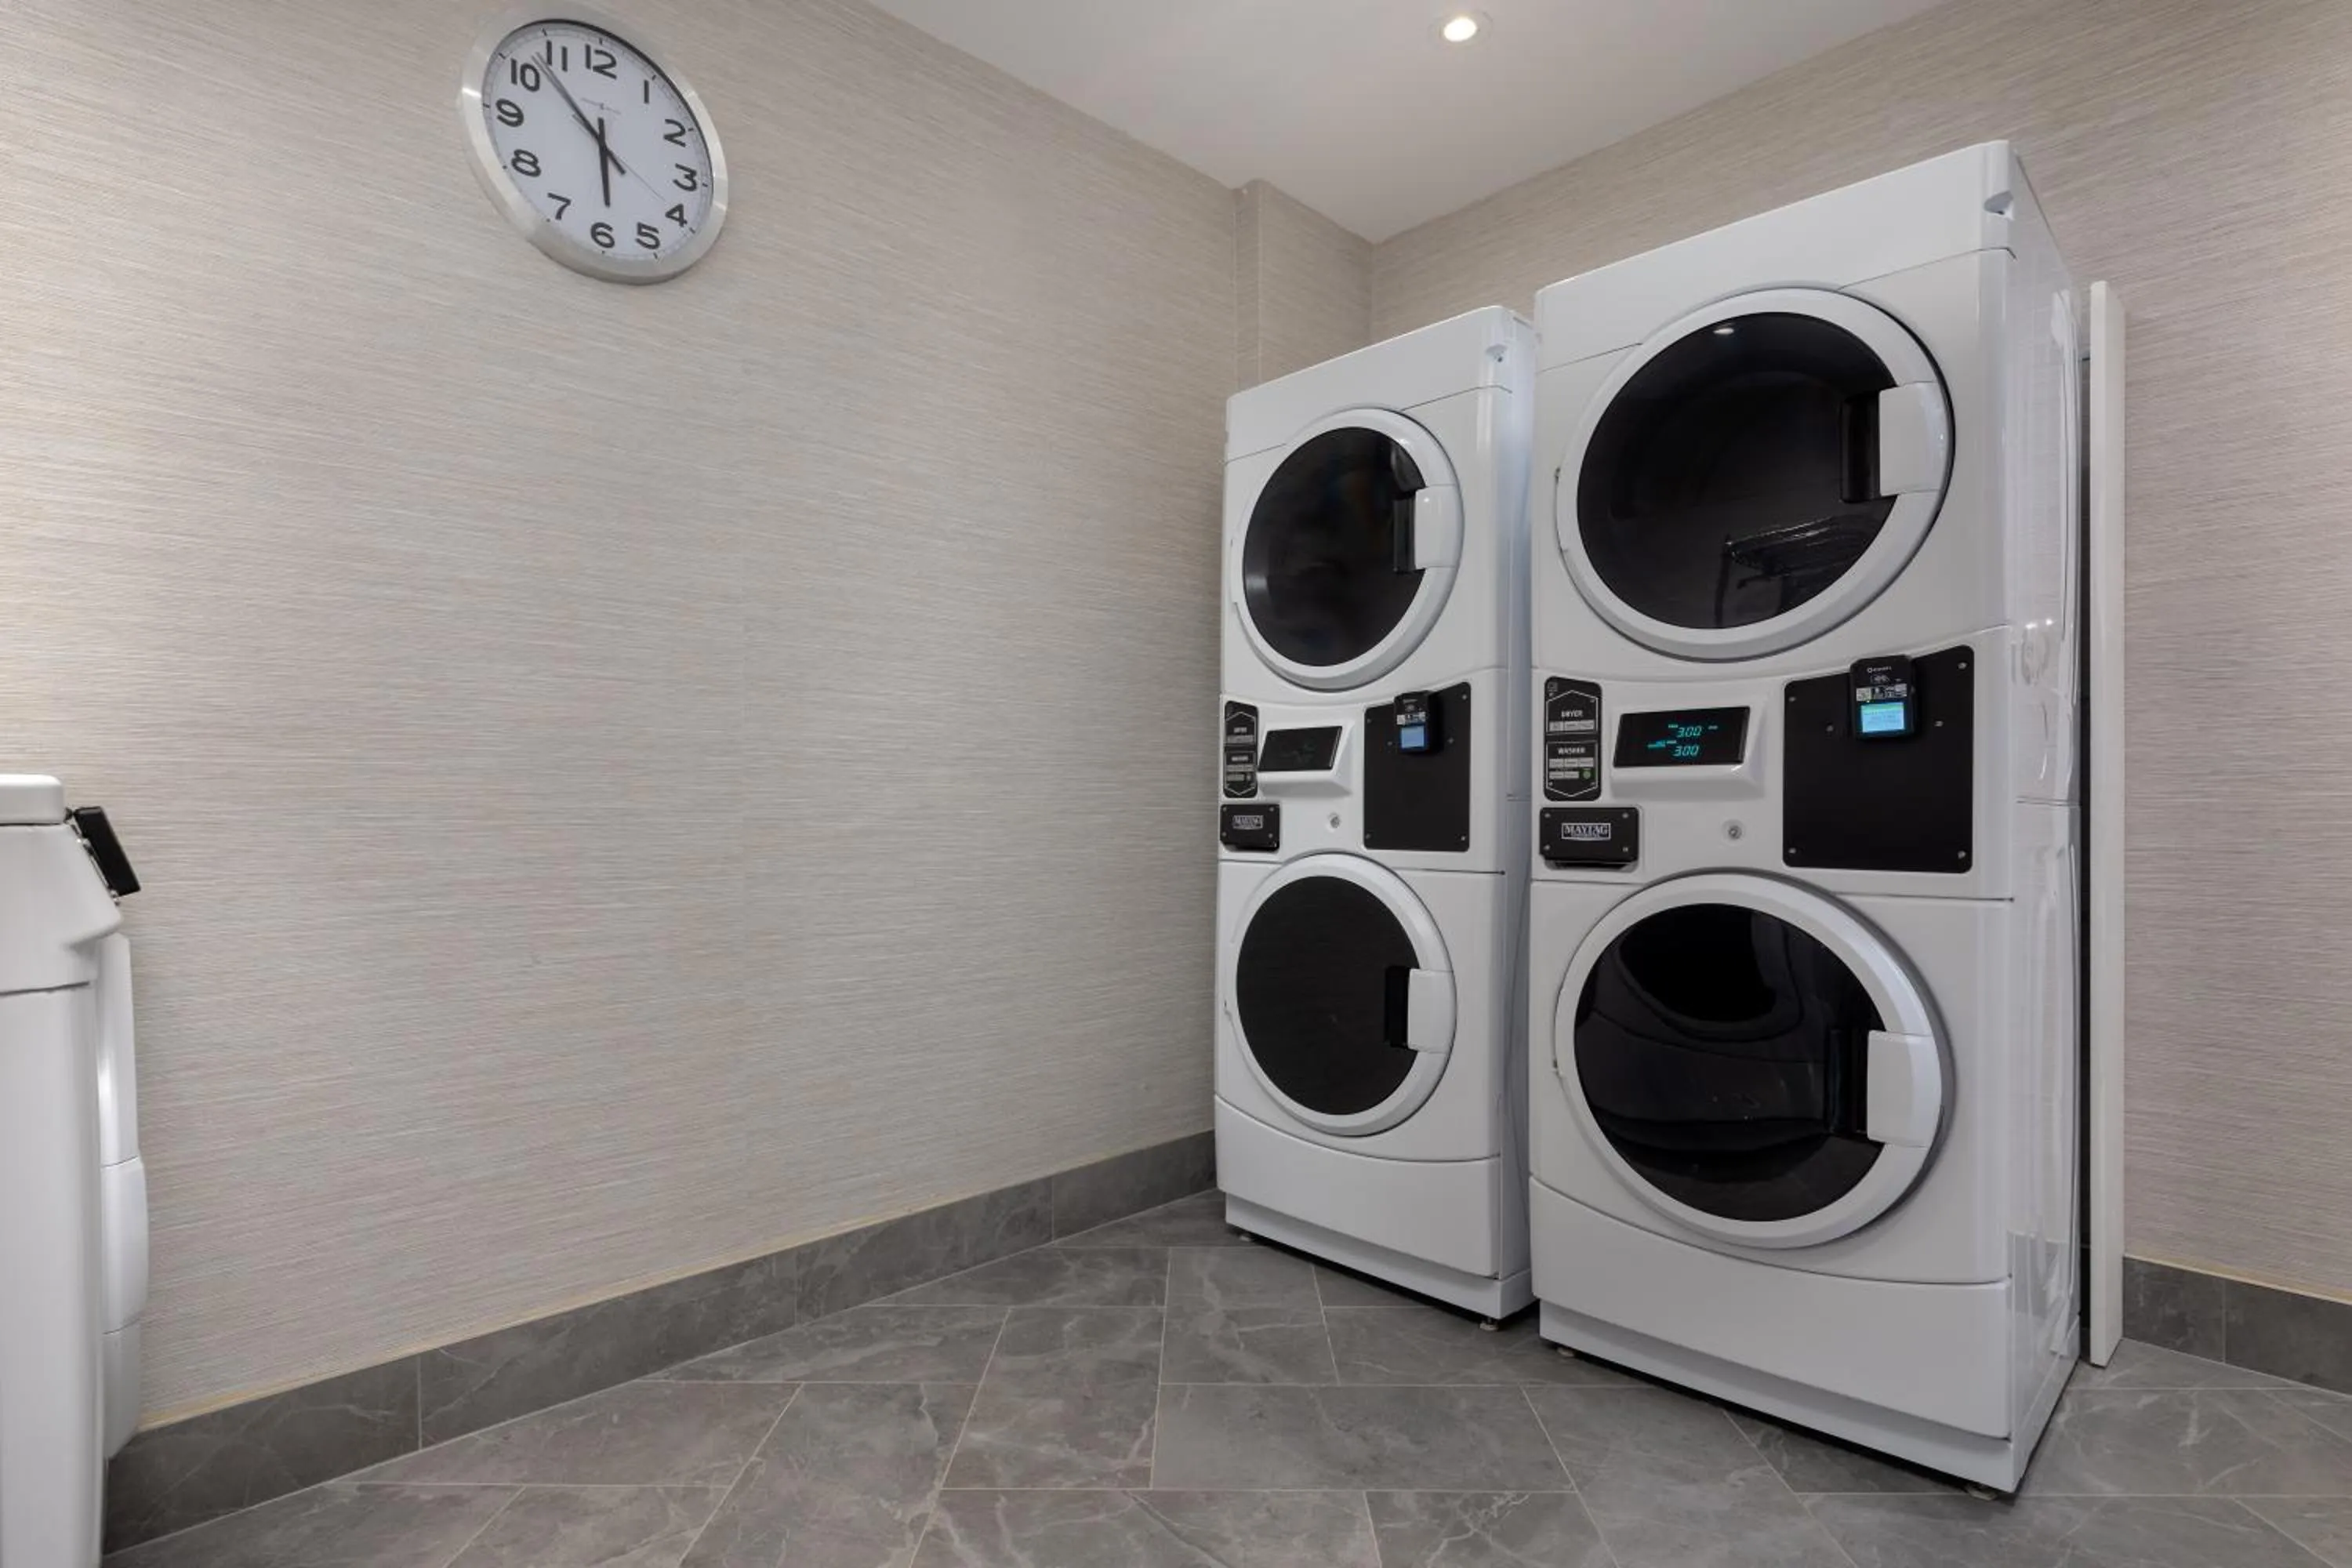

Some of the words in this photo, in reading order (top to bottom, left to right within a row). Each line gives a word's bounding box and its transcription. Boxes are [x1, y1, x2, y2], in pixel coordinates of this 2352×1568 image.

[546, 40, 568, 72] 11
[585, 44, 617, 80] 12
[510, 58, 541, 93] 10
[644, 80, 650, 103] 1
[495, 98, 524, 127] 9
[663, 118, 686, 147] 2
[511, 149, 541, 177] 8
[673, 163, 697, 192] 3
[547, 193, 572, 220] 7
[665, 204, 688, 227] 4
[590, 222, 615, 249] 6
[636, 222, 660, 250] 5
[1563, 825, 1608, 835] MAYTAG
